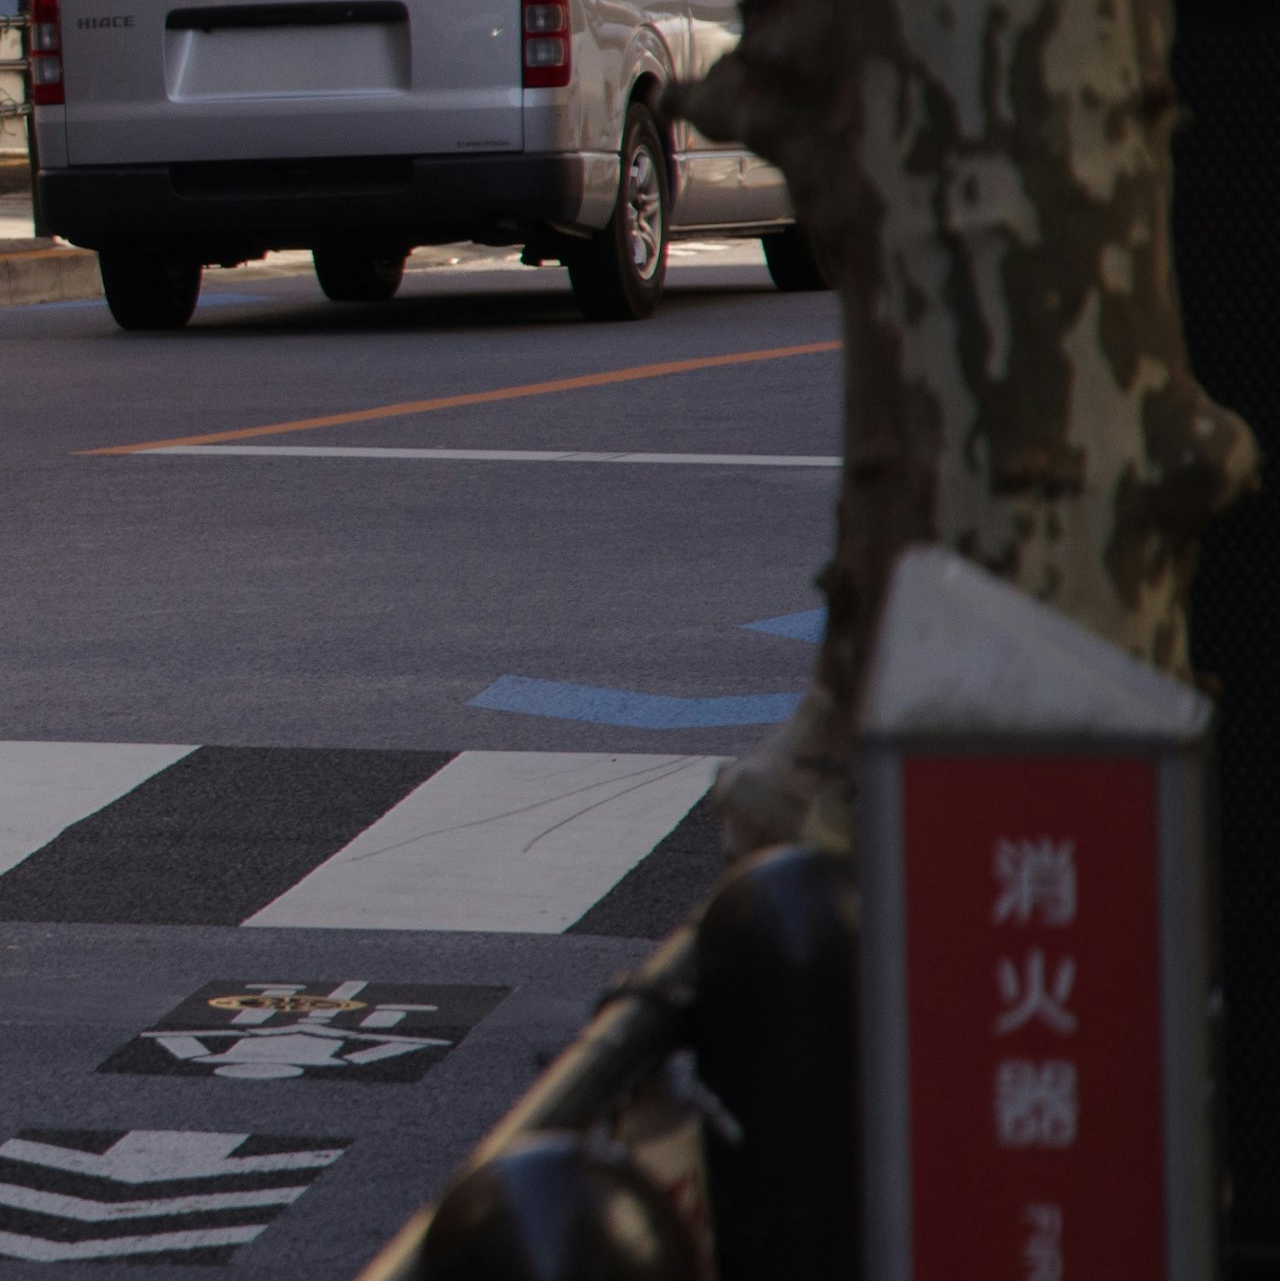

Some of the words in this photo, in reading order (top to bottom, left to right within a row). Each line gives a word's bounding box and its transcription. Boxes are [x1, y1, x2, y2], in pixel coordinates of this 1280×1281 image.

[78, 15, 136, 30] HIACE
[993, 835, 1078, 1148] 消火器
